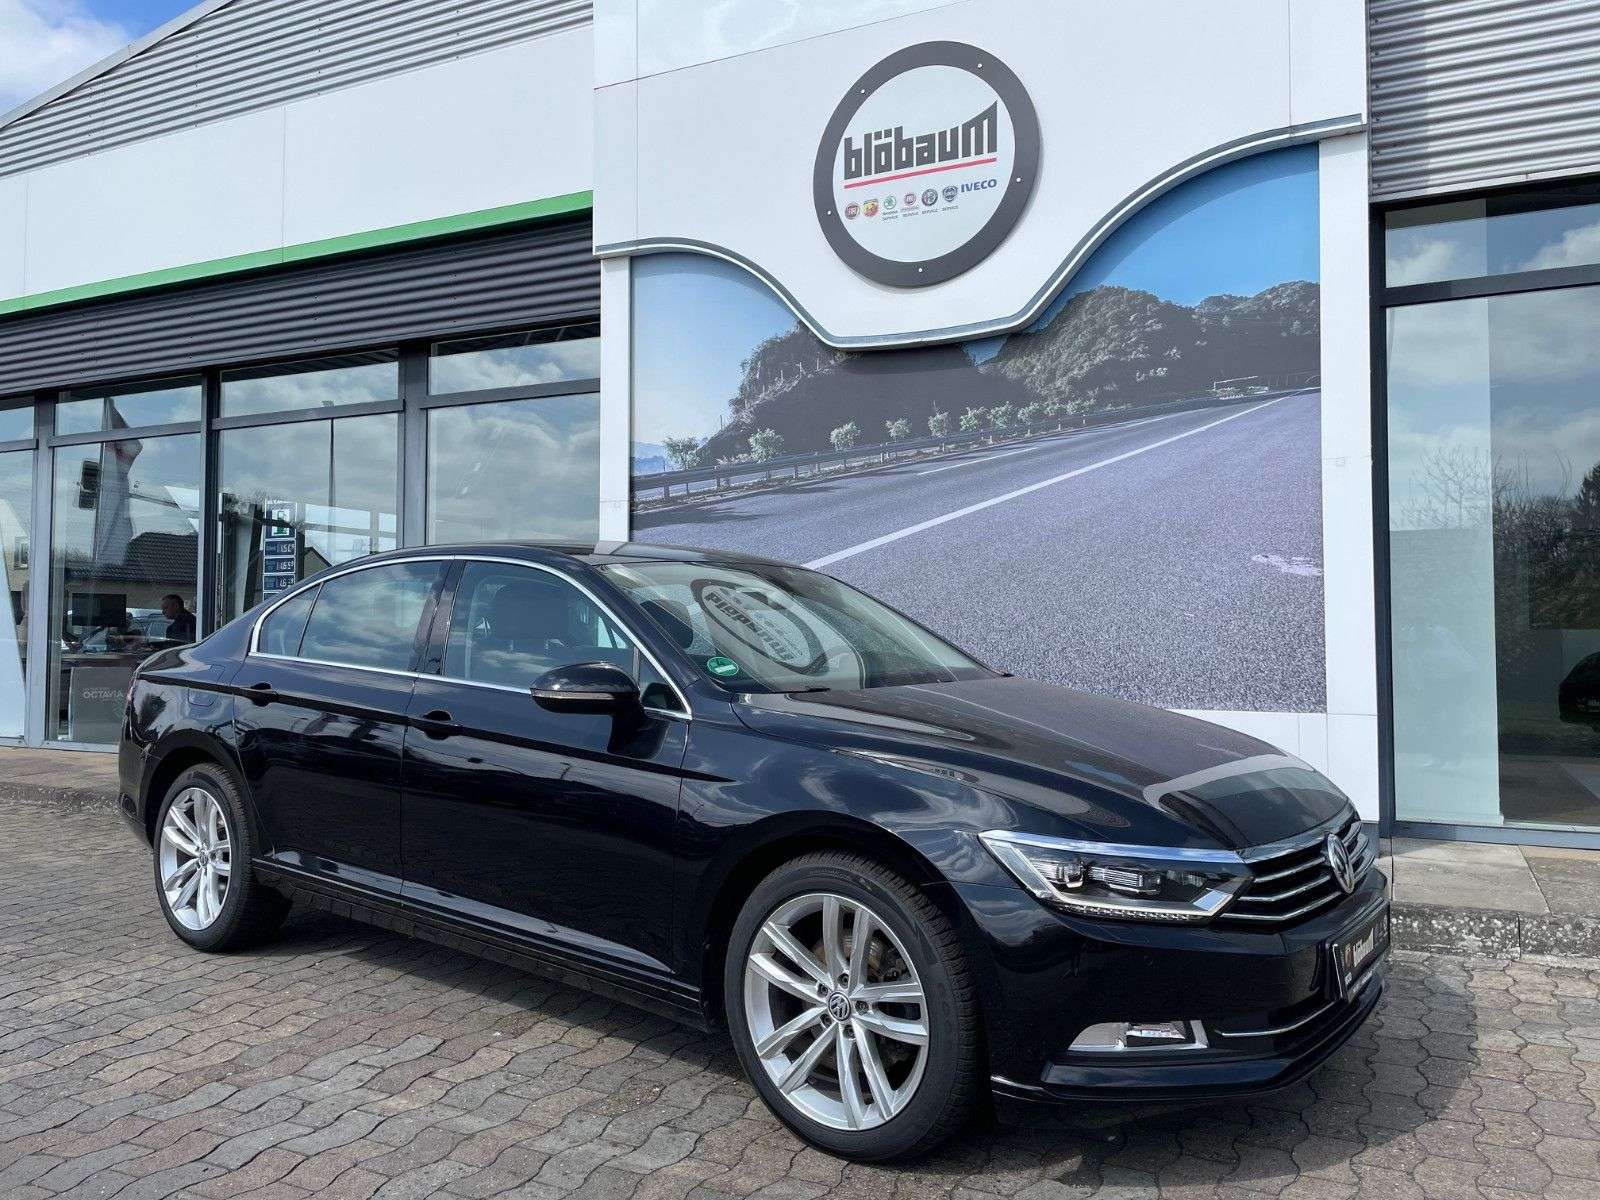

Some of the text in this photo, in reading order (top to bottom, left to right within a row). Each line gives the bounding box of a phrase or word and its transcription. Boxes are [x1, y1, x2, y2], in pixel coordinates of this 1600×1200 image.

[844, 100, 998, 180] blöbaum
[961, 178, 997, 193] IVECO
[83, 690, 124, 699] OCTAVIA
